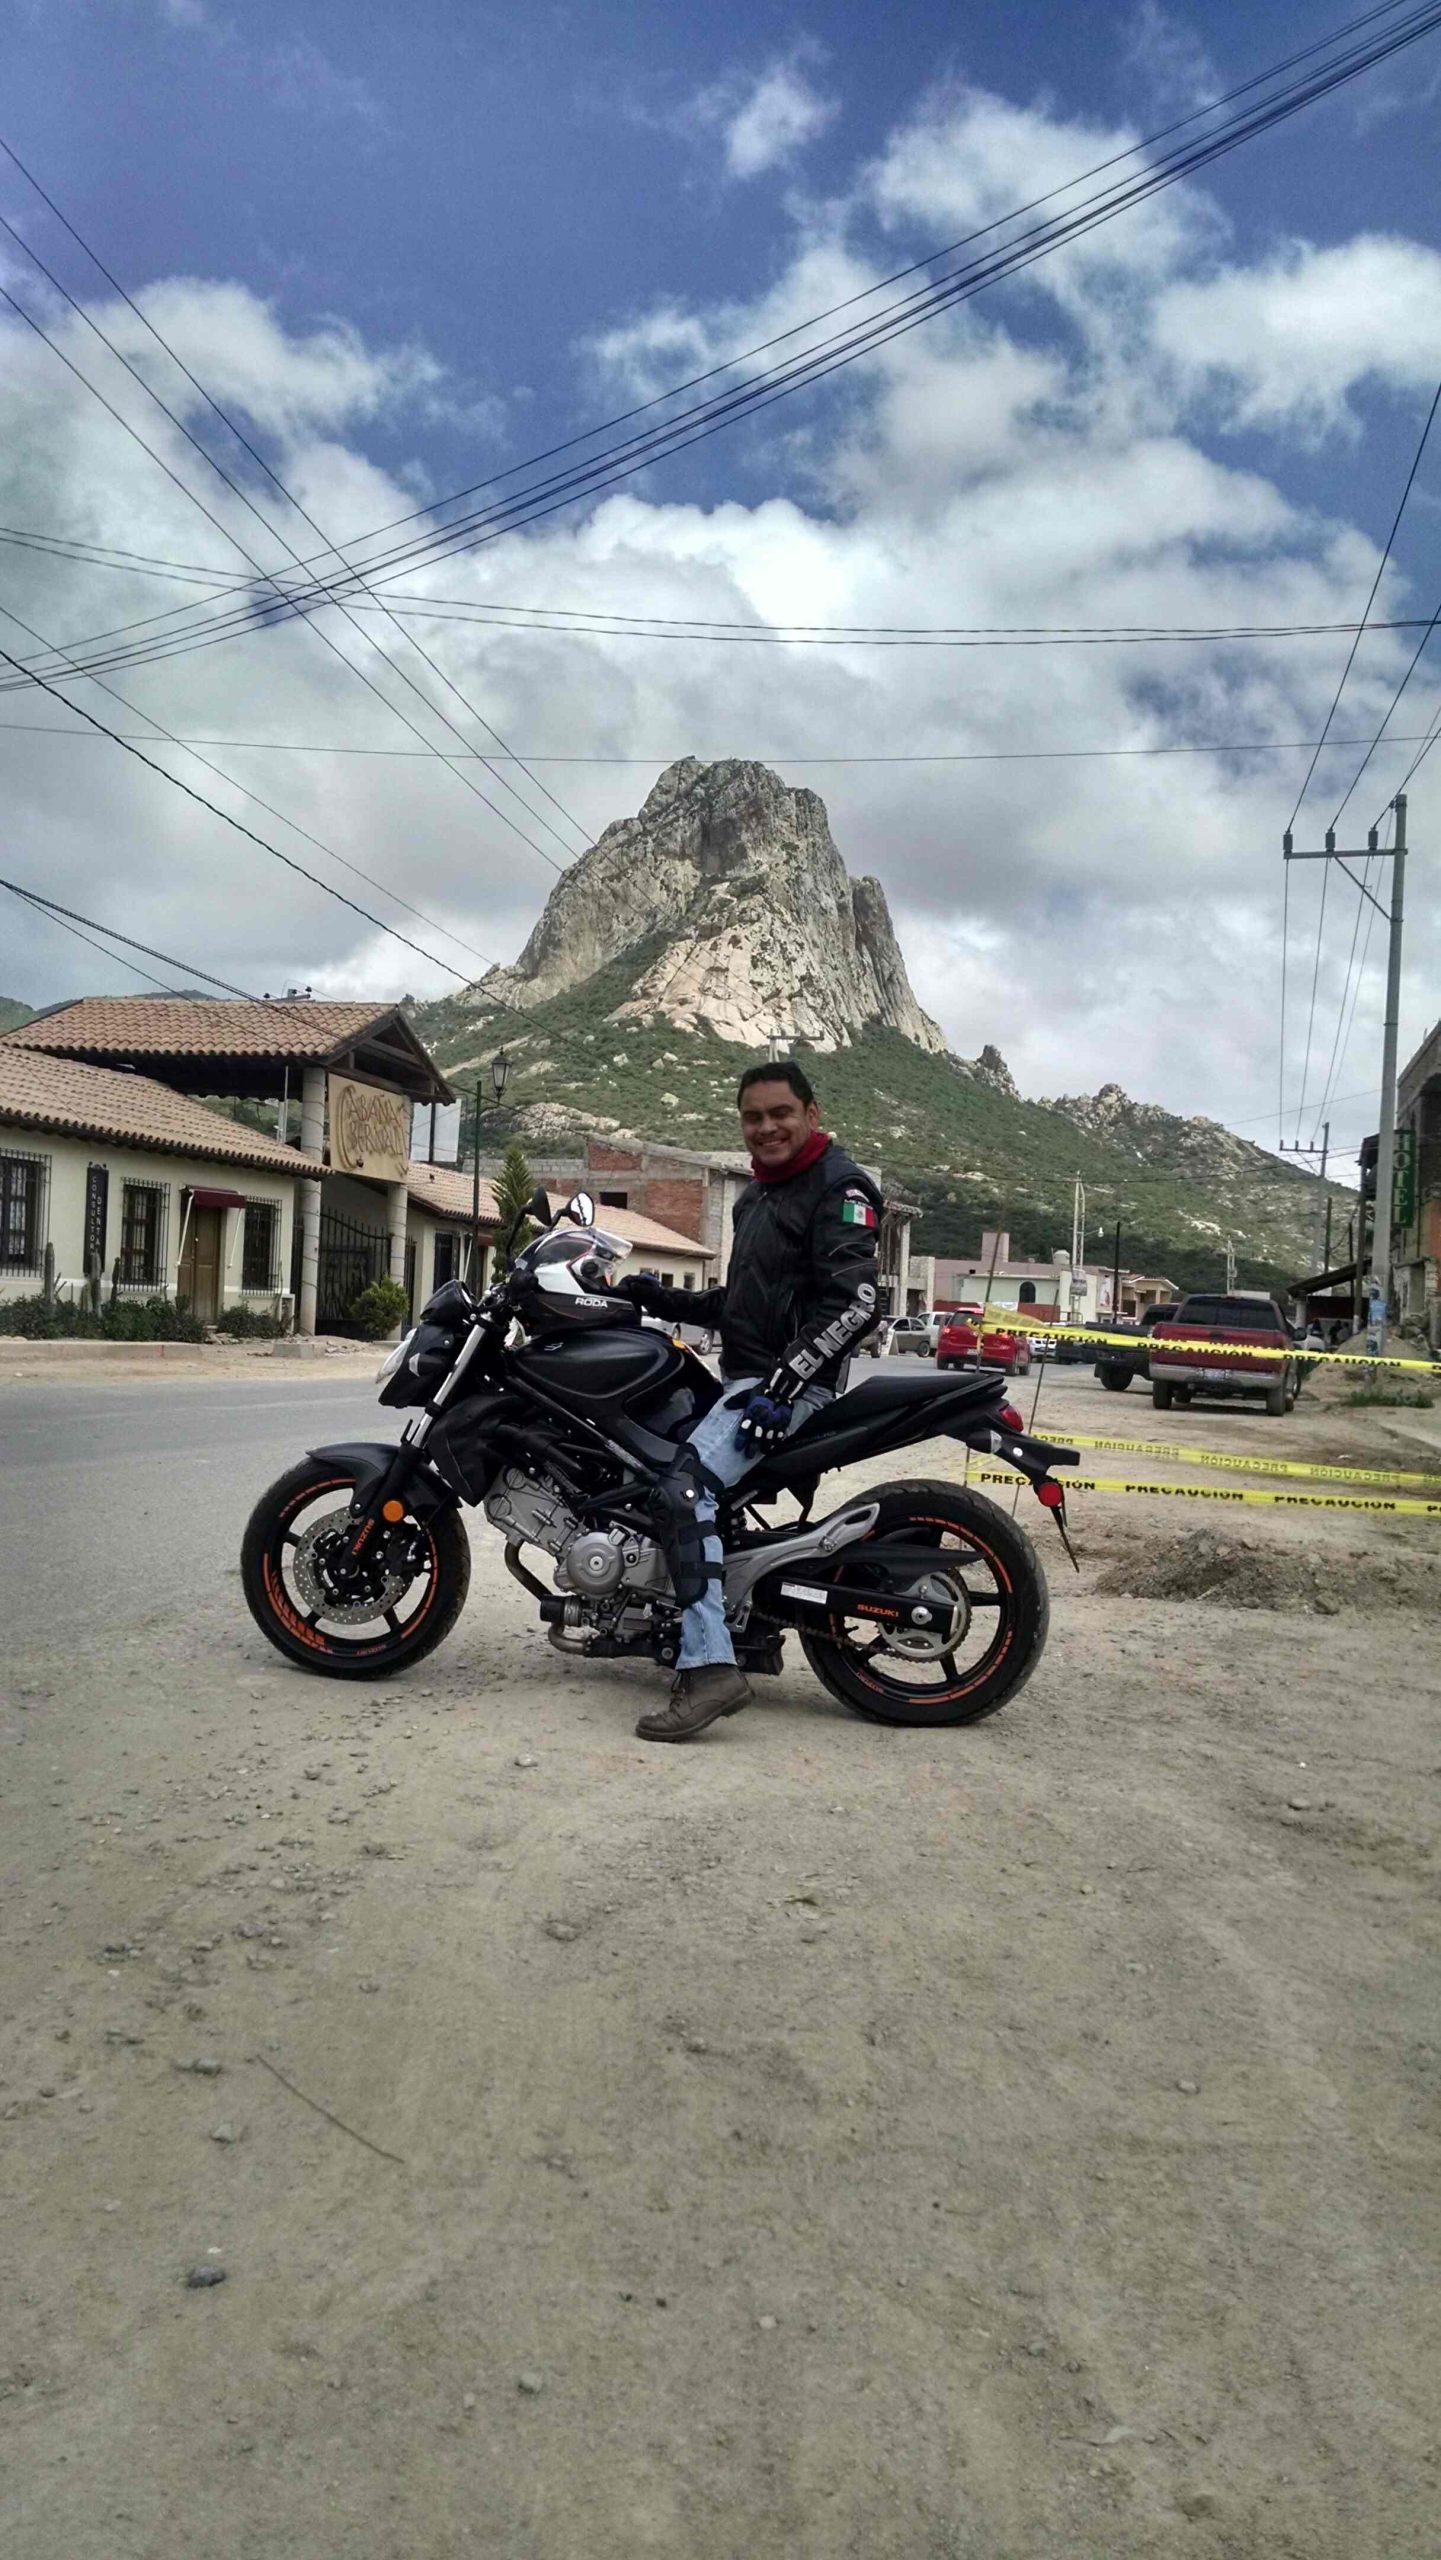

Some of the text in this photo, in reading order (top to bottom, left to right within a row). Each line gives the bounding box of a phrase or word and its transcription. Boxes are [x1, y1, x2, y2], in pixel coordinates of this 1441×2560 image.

[1393, 1133, 1411, 1223] HOTEL
[575, 1296, 608, 1309] RODA
[788, 1282, 876, 1380] EL NEGRO
[857, 1603, 899, 1618] SUZUKI
